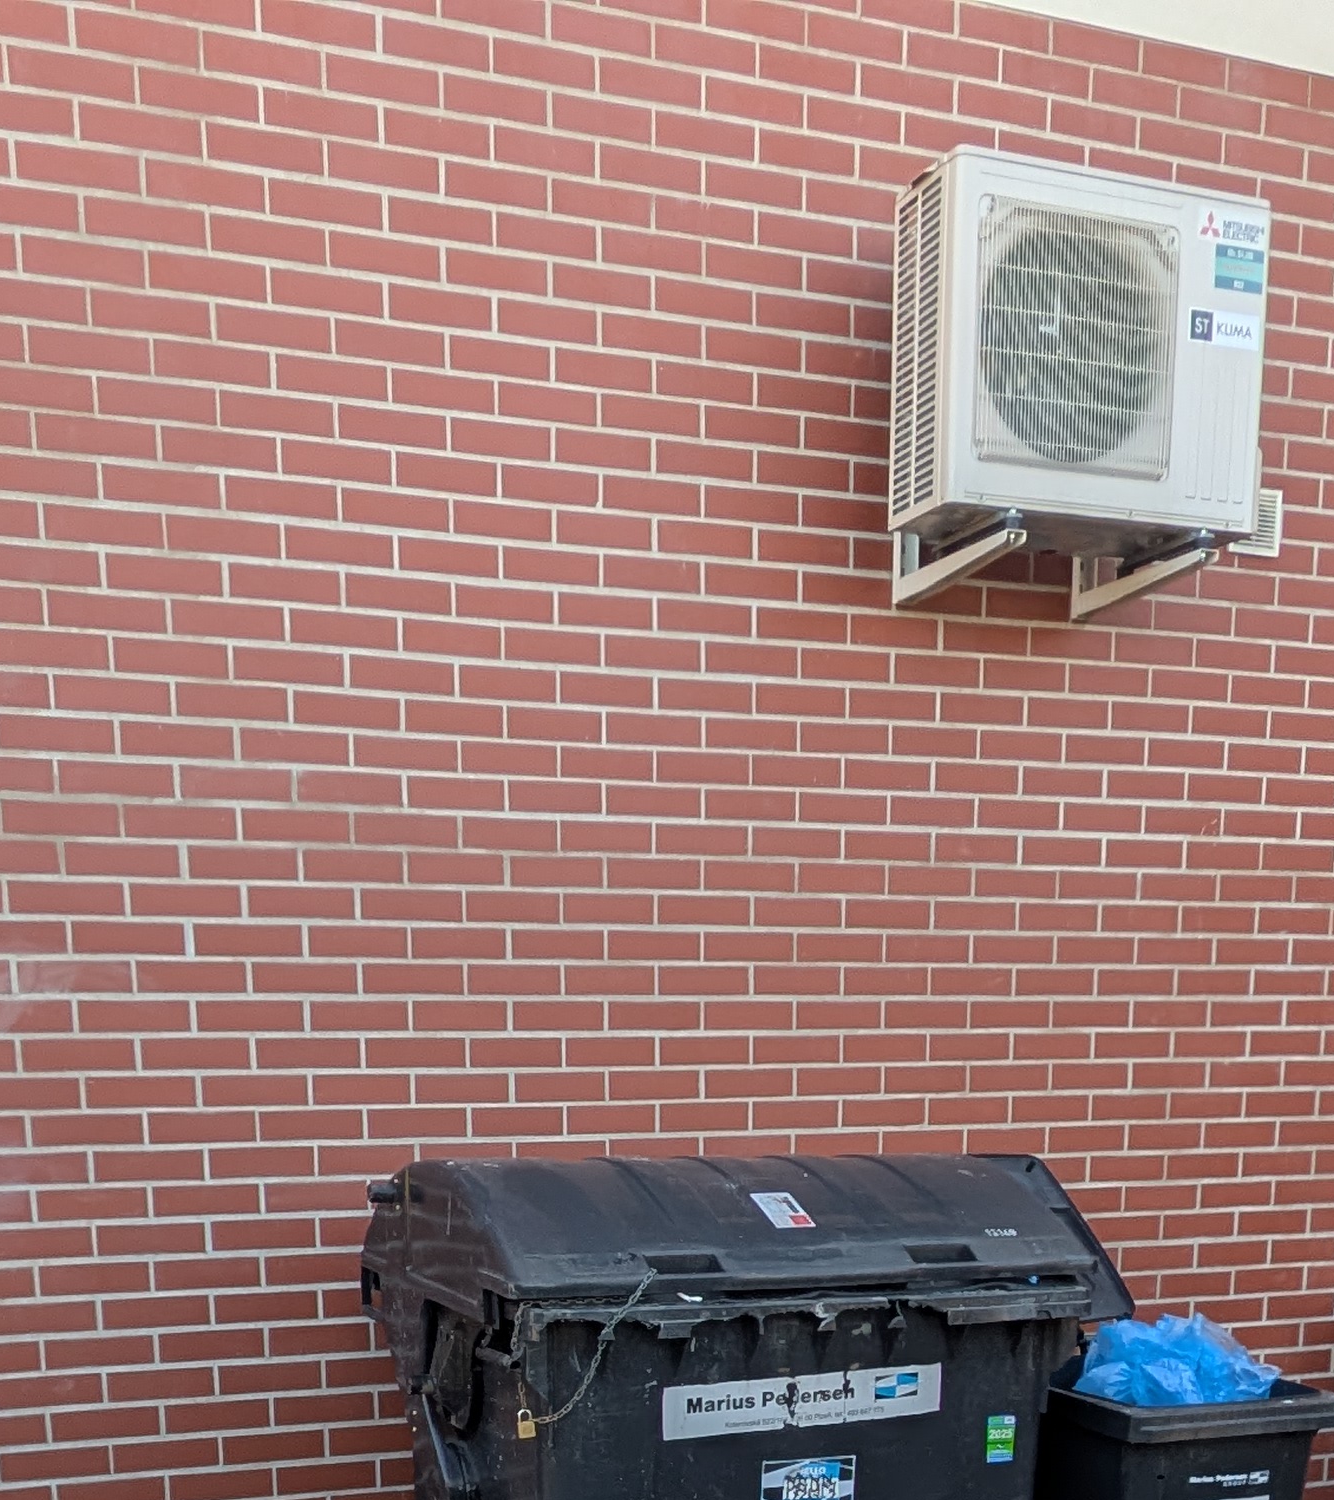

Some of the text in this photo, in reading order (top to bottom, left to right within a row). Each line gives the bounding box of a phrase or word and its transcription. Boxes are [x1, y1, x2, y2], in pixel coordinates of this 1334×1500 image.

[1223, 229, 1259, 243] ELECTRIC
[1195, 317, 1252, 340] ST KUMA
[686, 1393, 755, 1414] Marius
[988, 1429, 1013, 1439] 2025
